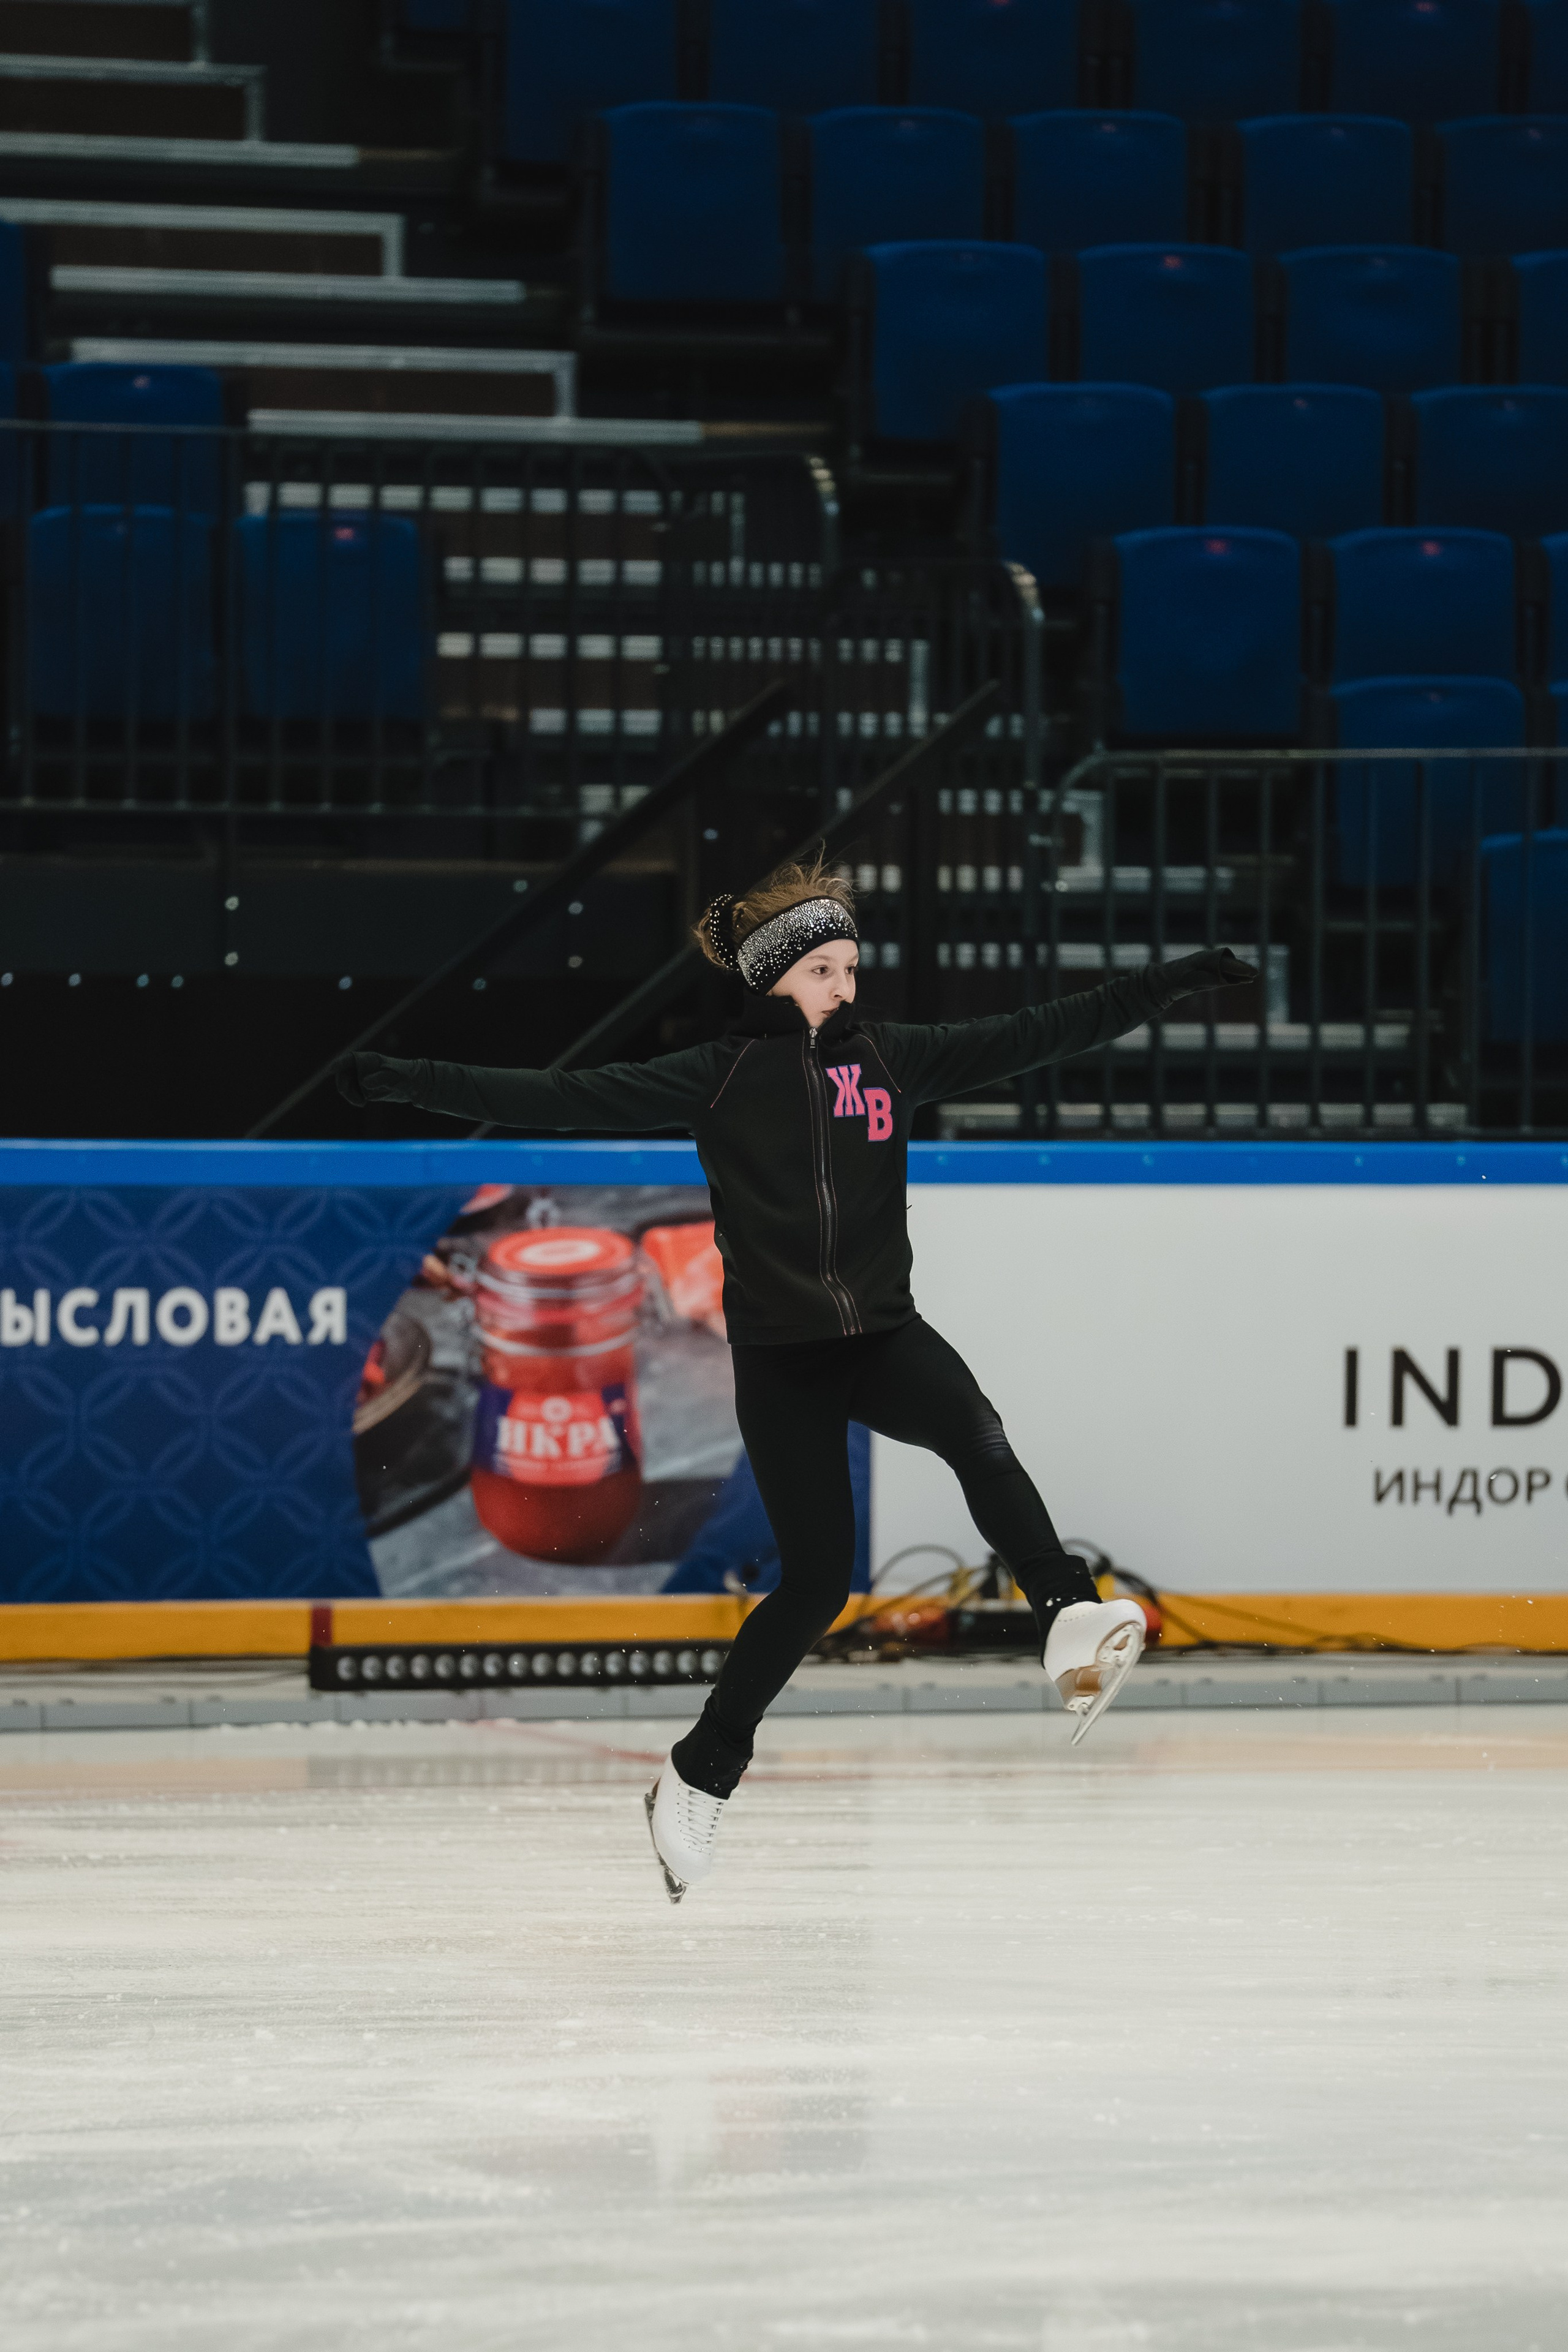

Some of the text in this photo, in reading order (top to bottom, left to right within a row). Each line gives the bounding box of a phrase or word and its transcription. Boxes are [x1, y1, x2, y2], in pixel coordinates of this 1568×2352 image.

[0, 1286, 348, 1347] ЫСЛОВАЯ
[1344, 1346, 1562, 1428] IND
[1374, 1468, 1551, 1516] ИНДОР
